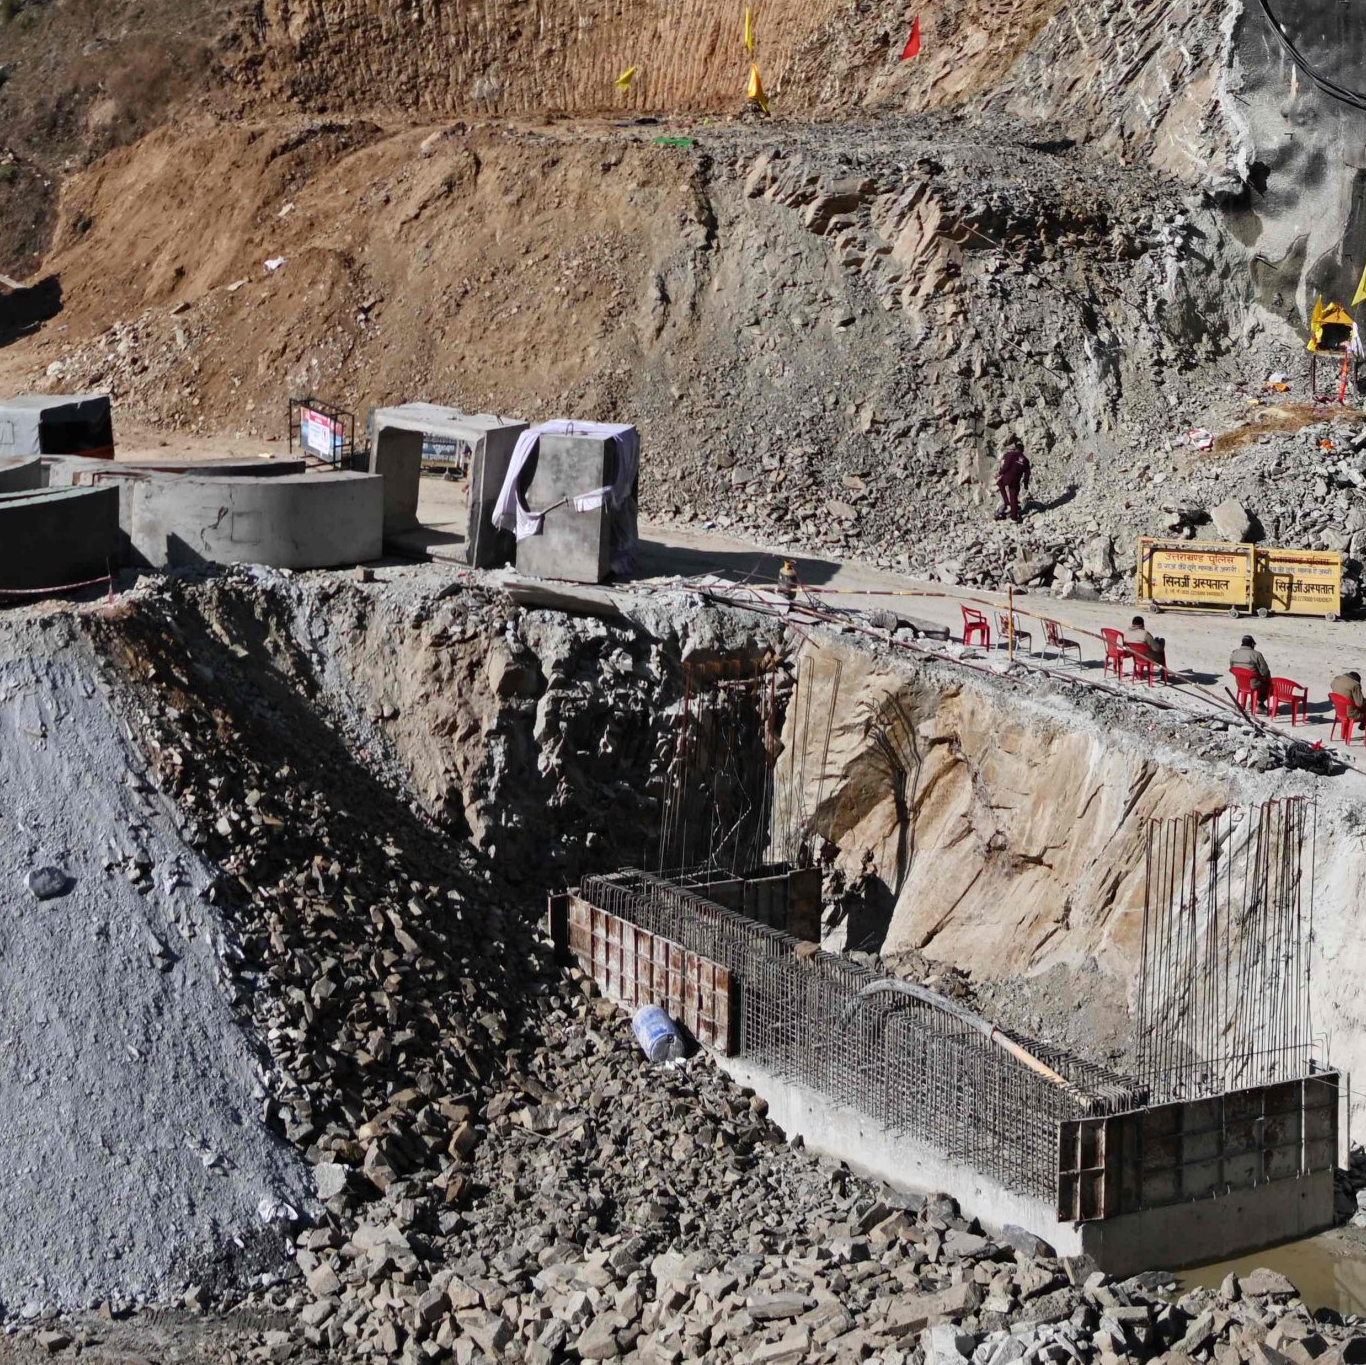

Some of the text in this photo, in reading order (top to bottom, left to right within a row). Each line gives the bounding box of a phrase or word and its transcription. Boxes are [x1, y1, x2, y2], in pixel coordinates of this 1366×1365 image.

[1163, 574, 1190, 589] सिनर्जी
[1192, 577, 1230, 591] अस्पताल
[1303, 582, 1336, 595] अस्पताल
